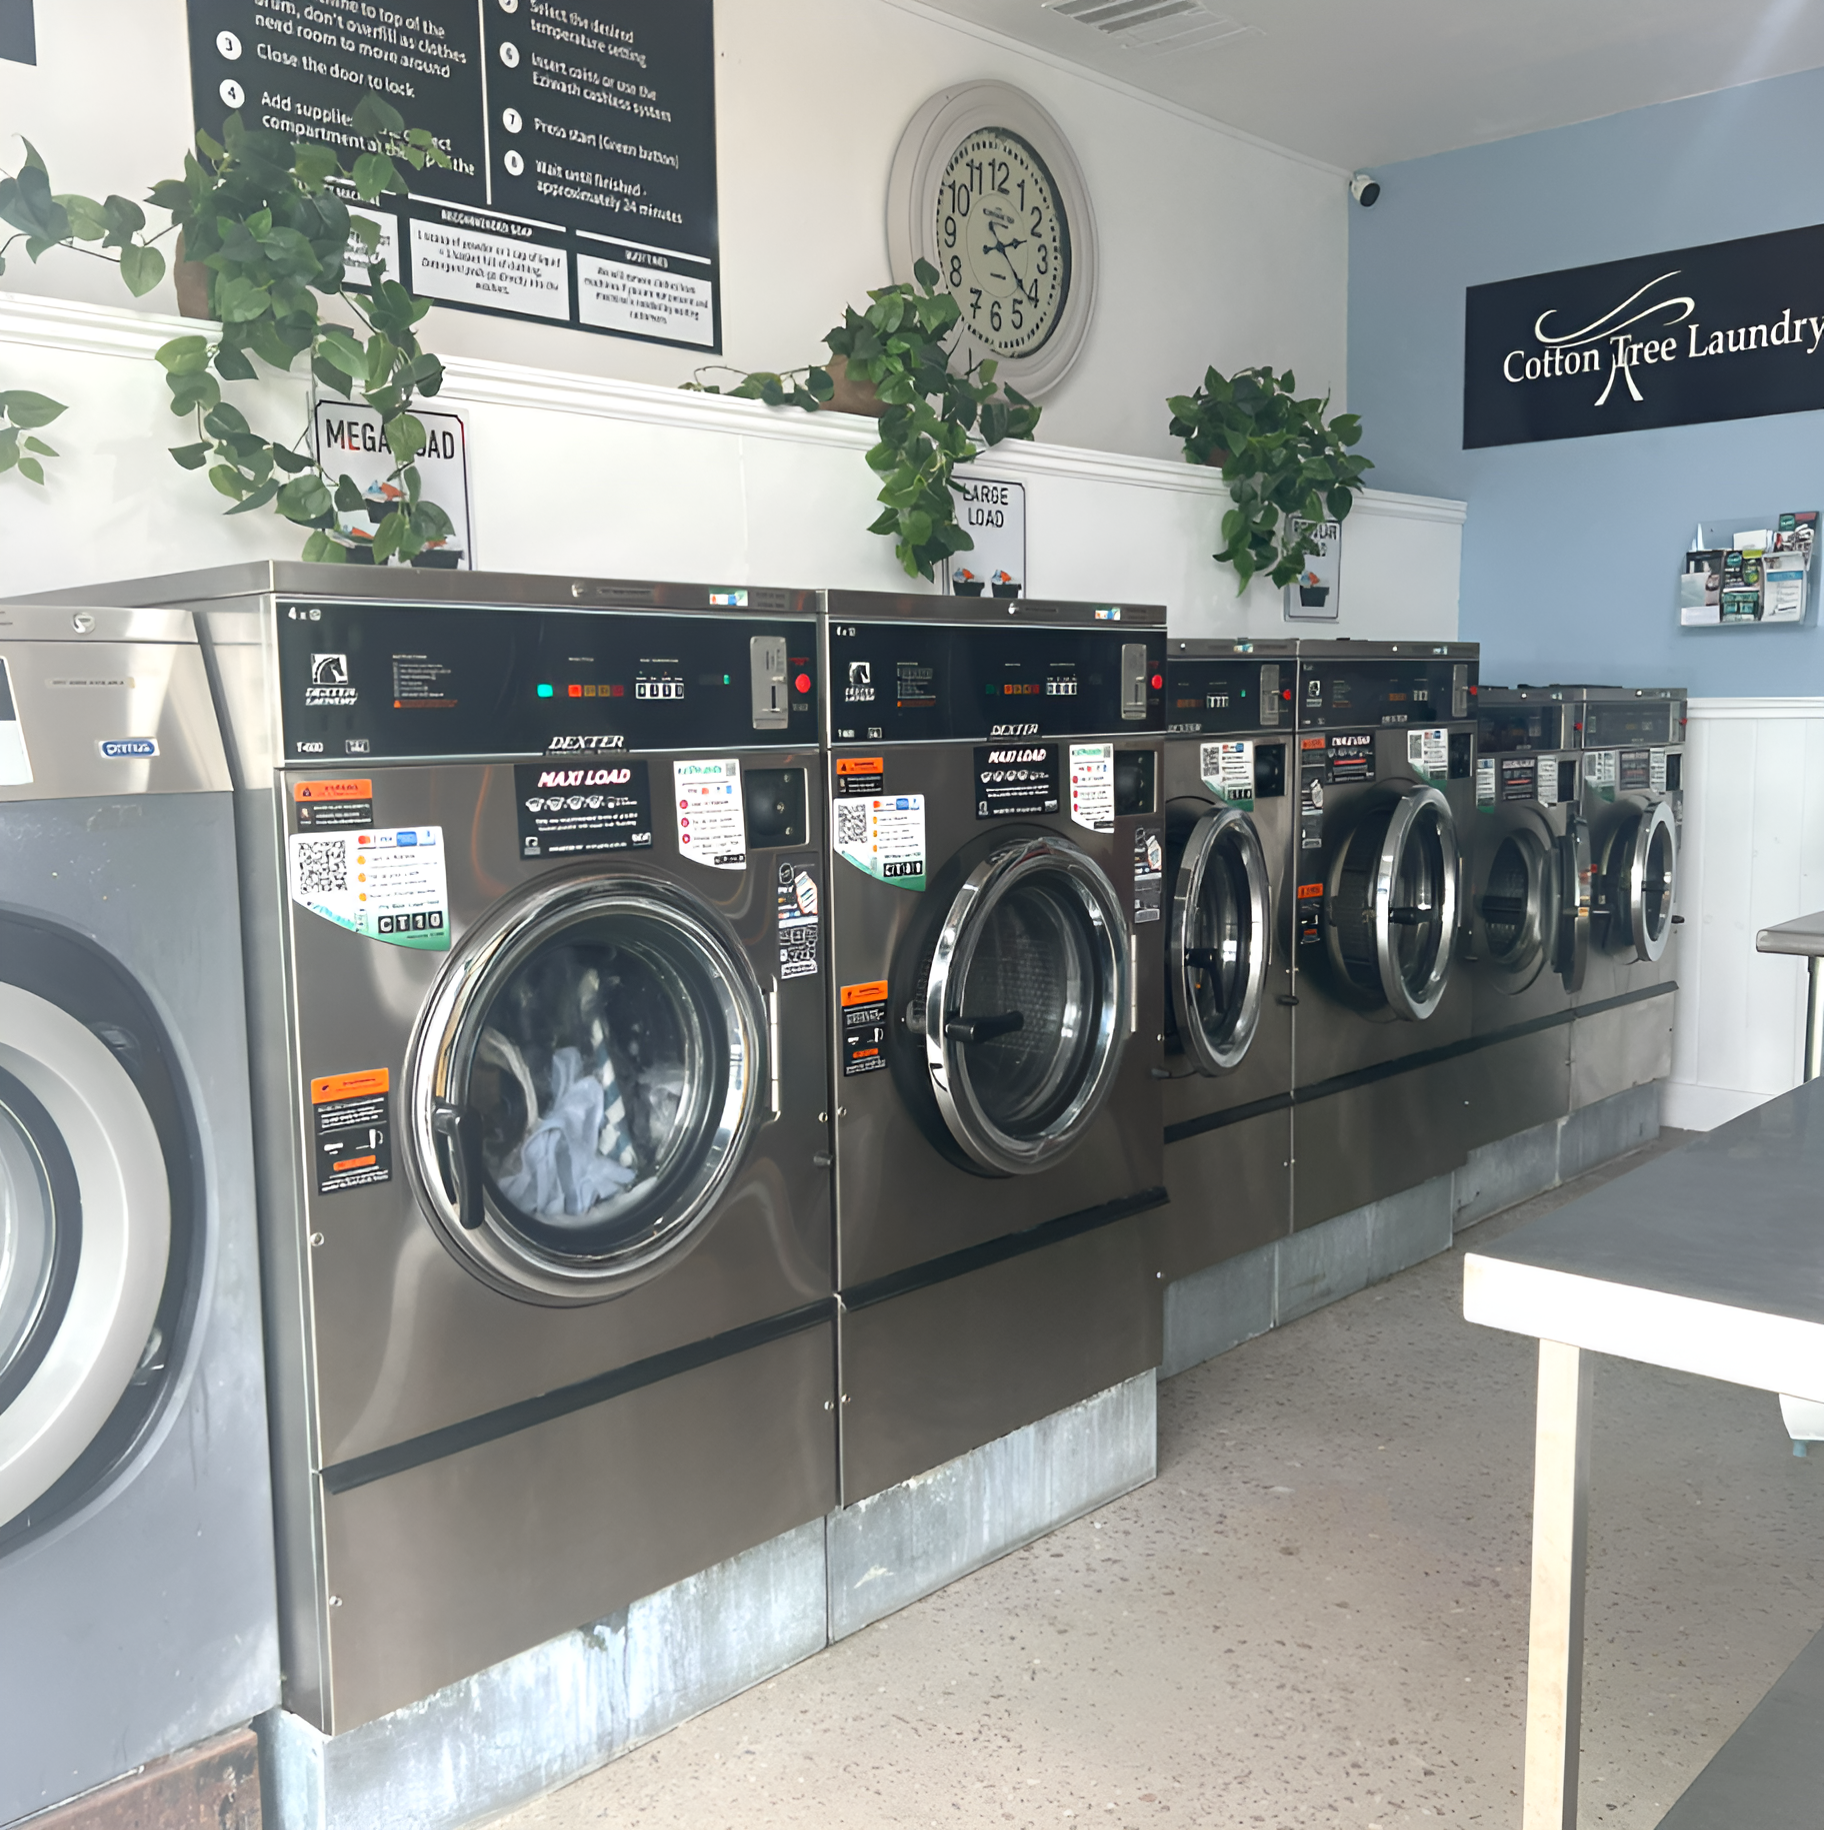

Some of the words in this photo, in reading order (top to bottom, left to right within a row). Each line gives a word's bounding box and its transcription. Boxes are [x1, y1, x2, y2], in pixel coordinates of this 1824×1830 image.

[304, 4, 344, 28] don't
[379, 7, 402, 28] top
[423, 20, 445, 38] the
[256, 43, 298, 68] Close
[301, 56, 328, 75] the
[330, 61, 364, 84] door
[367, 74, 382, 91] to
[297, 25, 337, 46] room
[340, 36, 356, 52] to
[400, 54, 451, 78] around
[261, 91, 292, 112] Add
[262, 114, 365, 151] compartment
[966, 158, 983, 195] 11
[988, 158, 1010, 195] 12
[948, 179, 970, 217] 10
[1017, 179, 1025, 212] 1
[944, 216, 957, 248] 9
[1030, 206, 1042, 238] 2
[950, 255, 962, 287] 8
[1037, 244, 1048, 275] 3
[970, 287, 982, 319] 7
[1027, 278, 1039, 308] 4
[990, 300, 1002, 332] 6
[1011, 298, 1024, 330] 5
[1503, 346, 1601, 383] Cotton
[1609, 334, 1677, 369] Tree
[1687, 308, 1824, 358] Laundry
[968, 507, 1005, 528] LOAD
[548, 735, 625, 750] DEXTER
[537, 769, 585, 788] MAXI
[584, 768, 631, 786] LOAD
